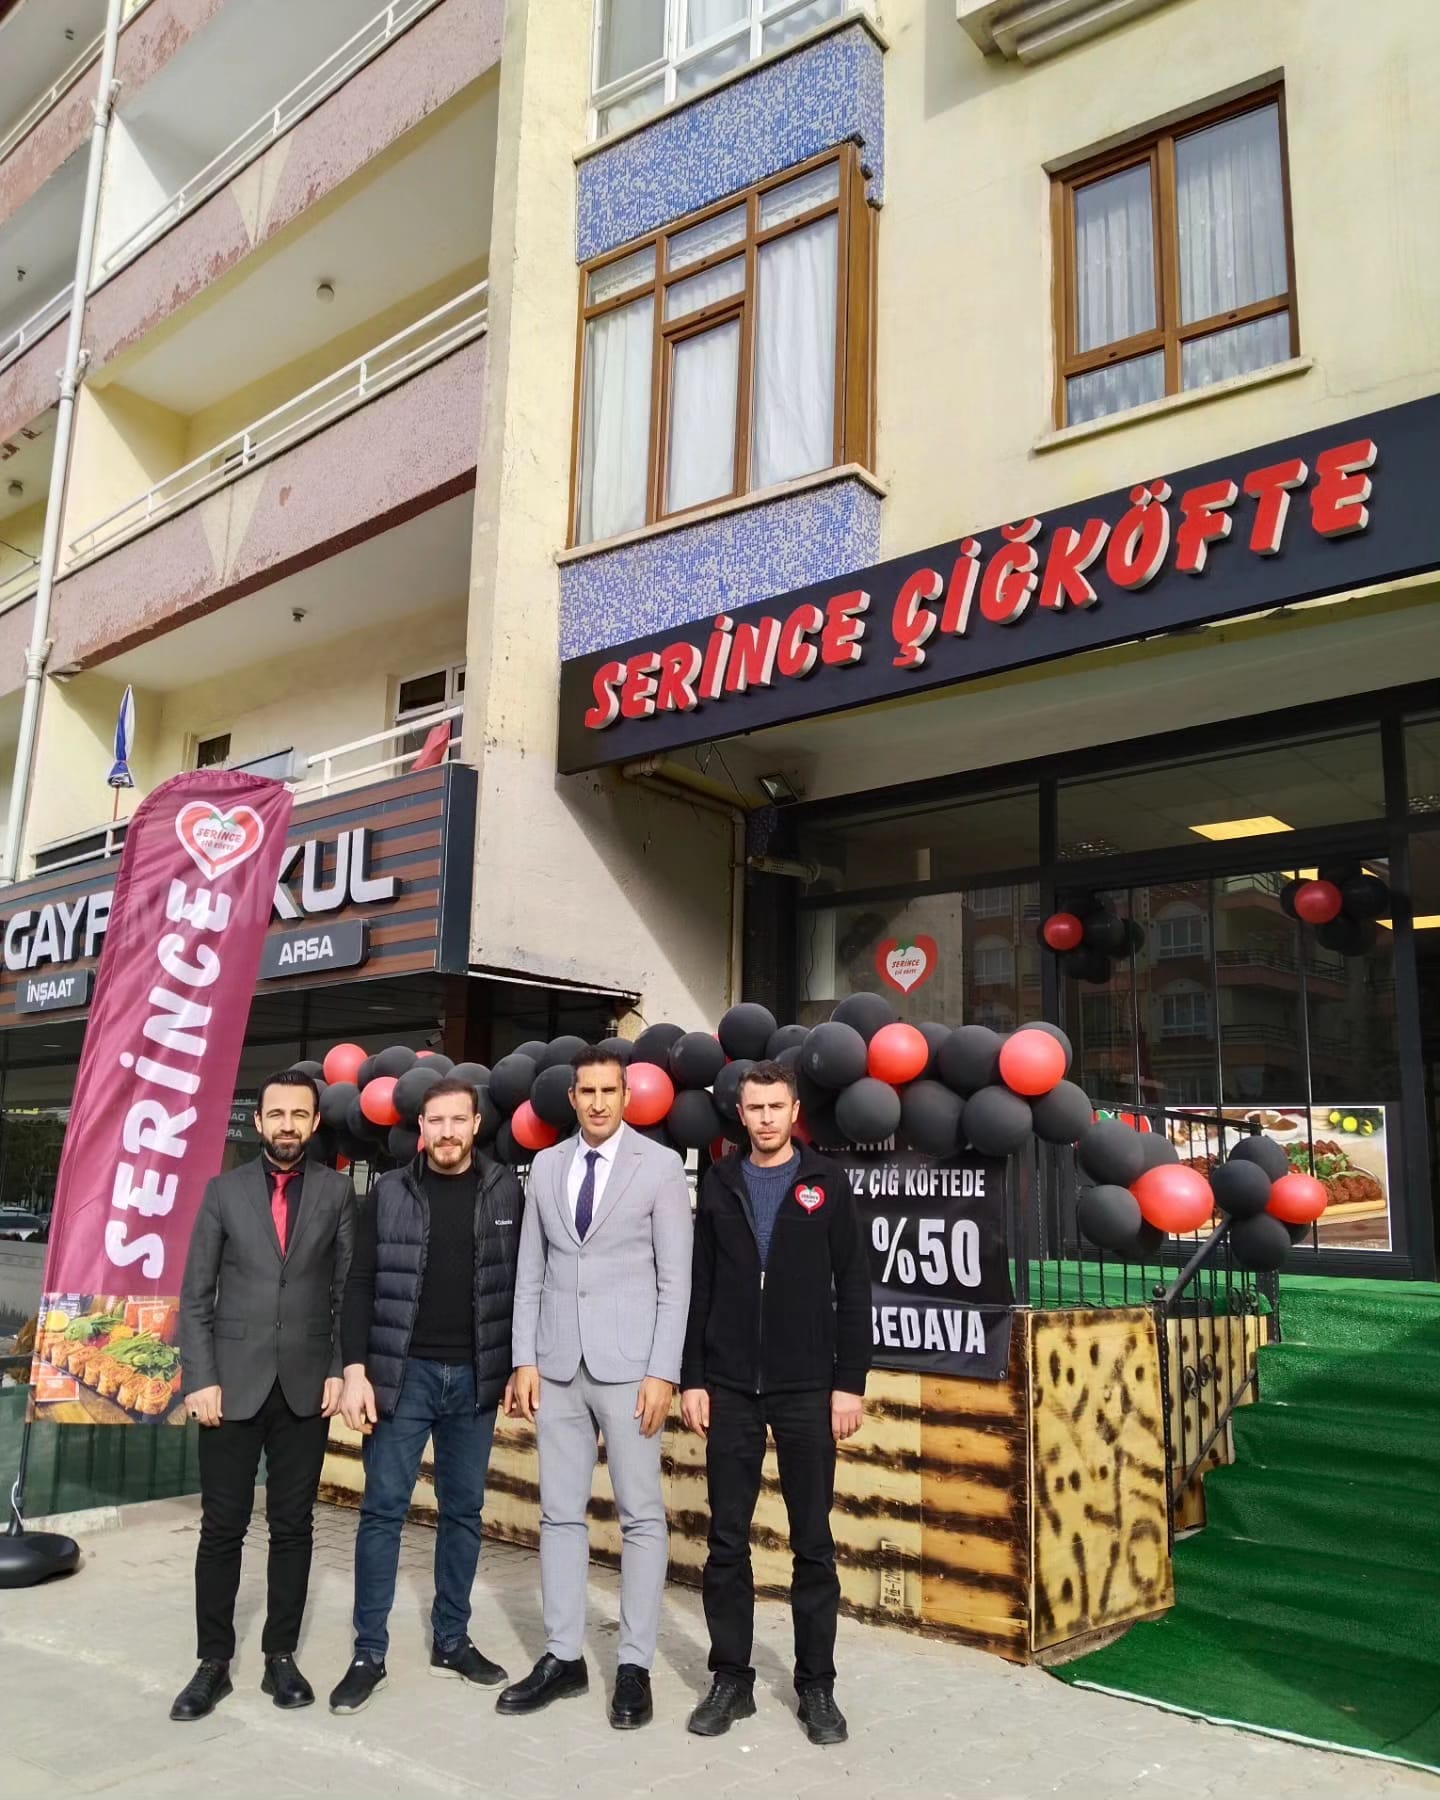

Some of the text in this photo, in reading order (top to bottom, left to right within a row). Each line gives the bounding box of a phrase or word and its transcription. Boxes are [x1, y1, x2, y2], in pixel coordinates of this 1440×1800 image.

[584, 589, 871, 730] SERİNCE
[278, 935, 334, 966] ARSA
[27, 979, 75, 1007] İNŞAAT
[105, 878, 232, 1280] SERİNCE
[869, 1163, 899, 1199] ÇİĞ
[905, 1164, 985, 1197] KÖFTEDE
[871, 1216, 982, 1288] %50
